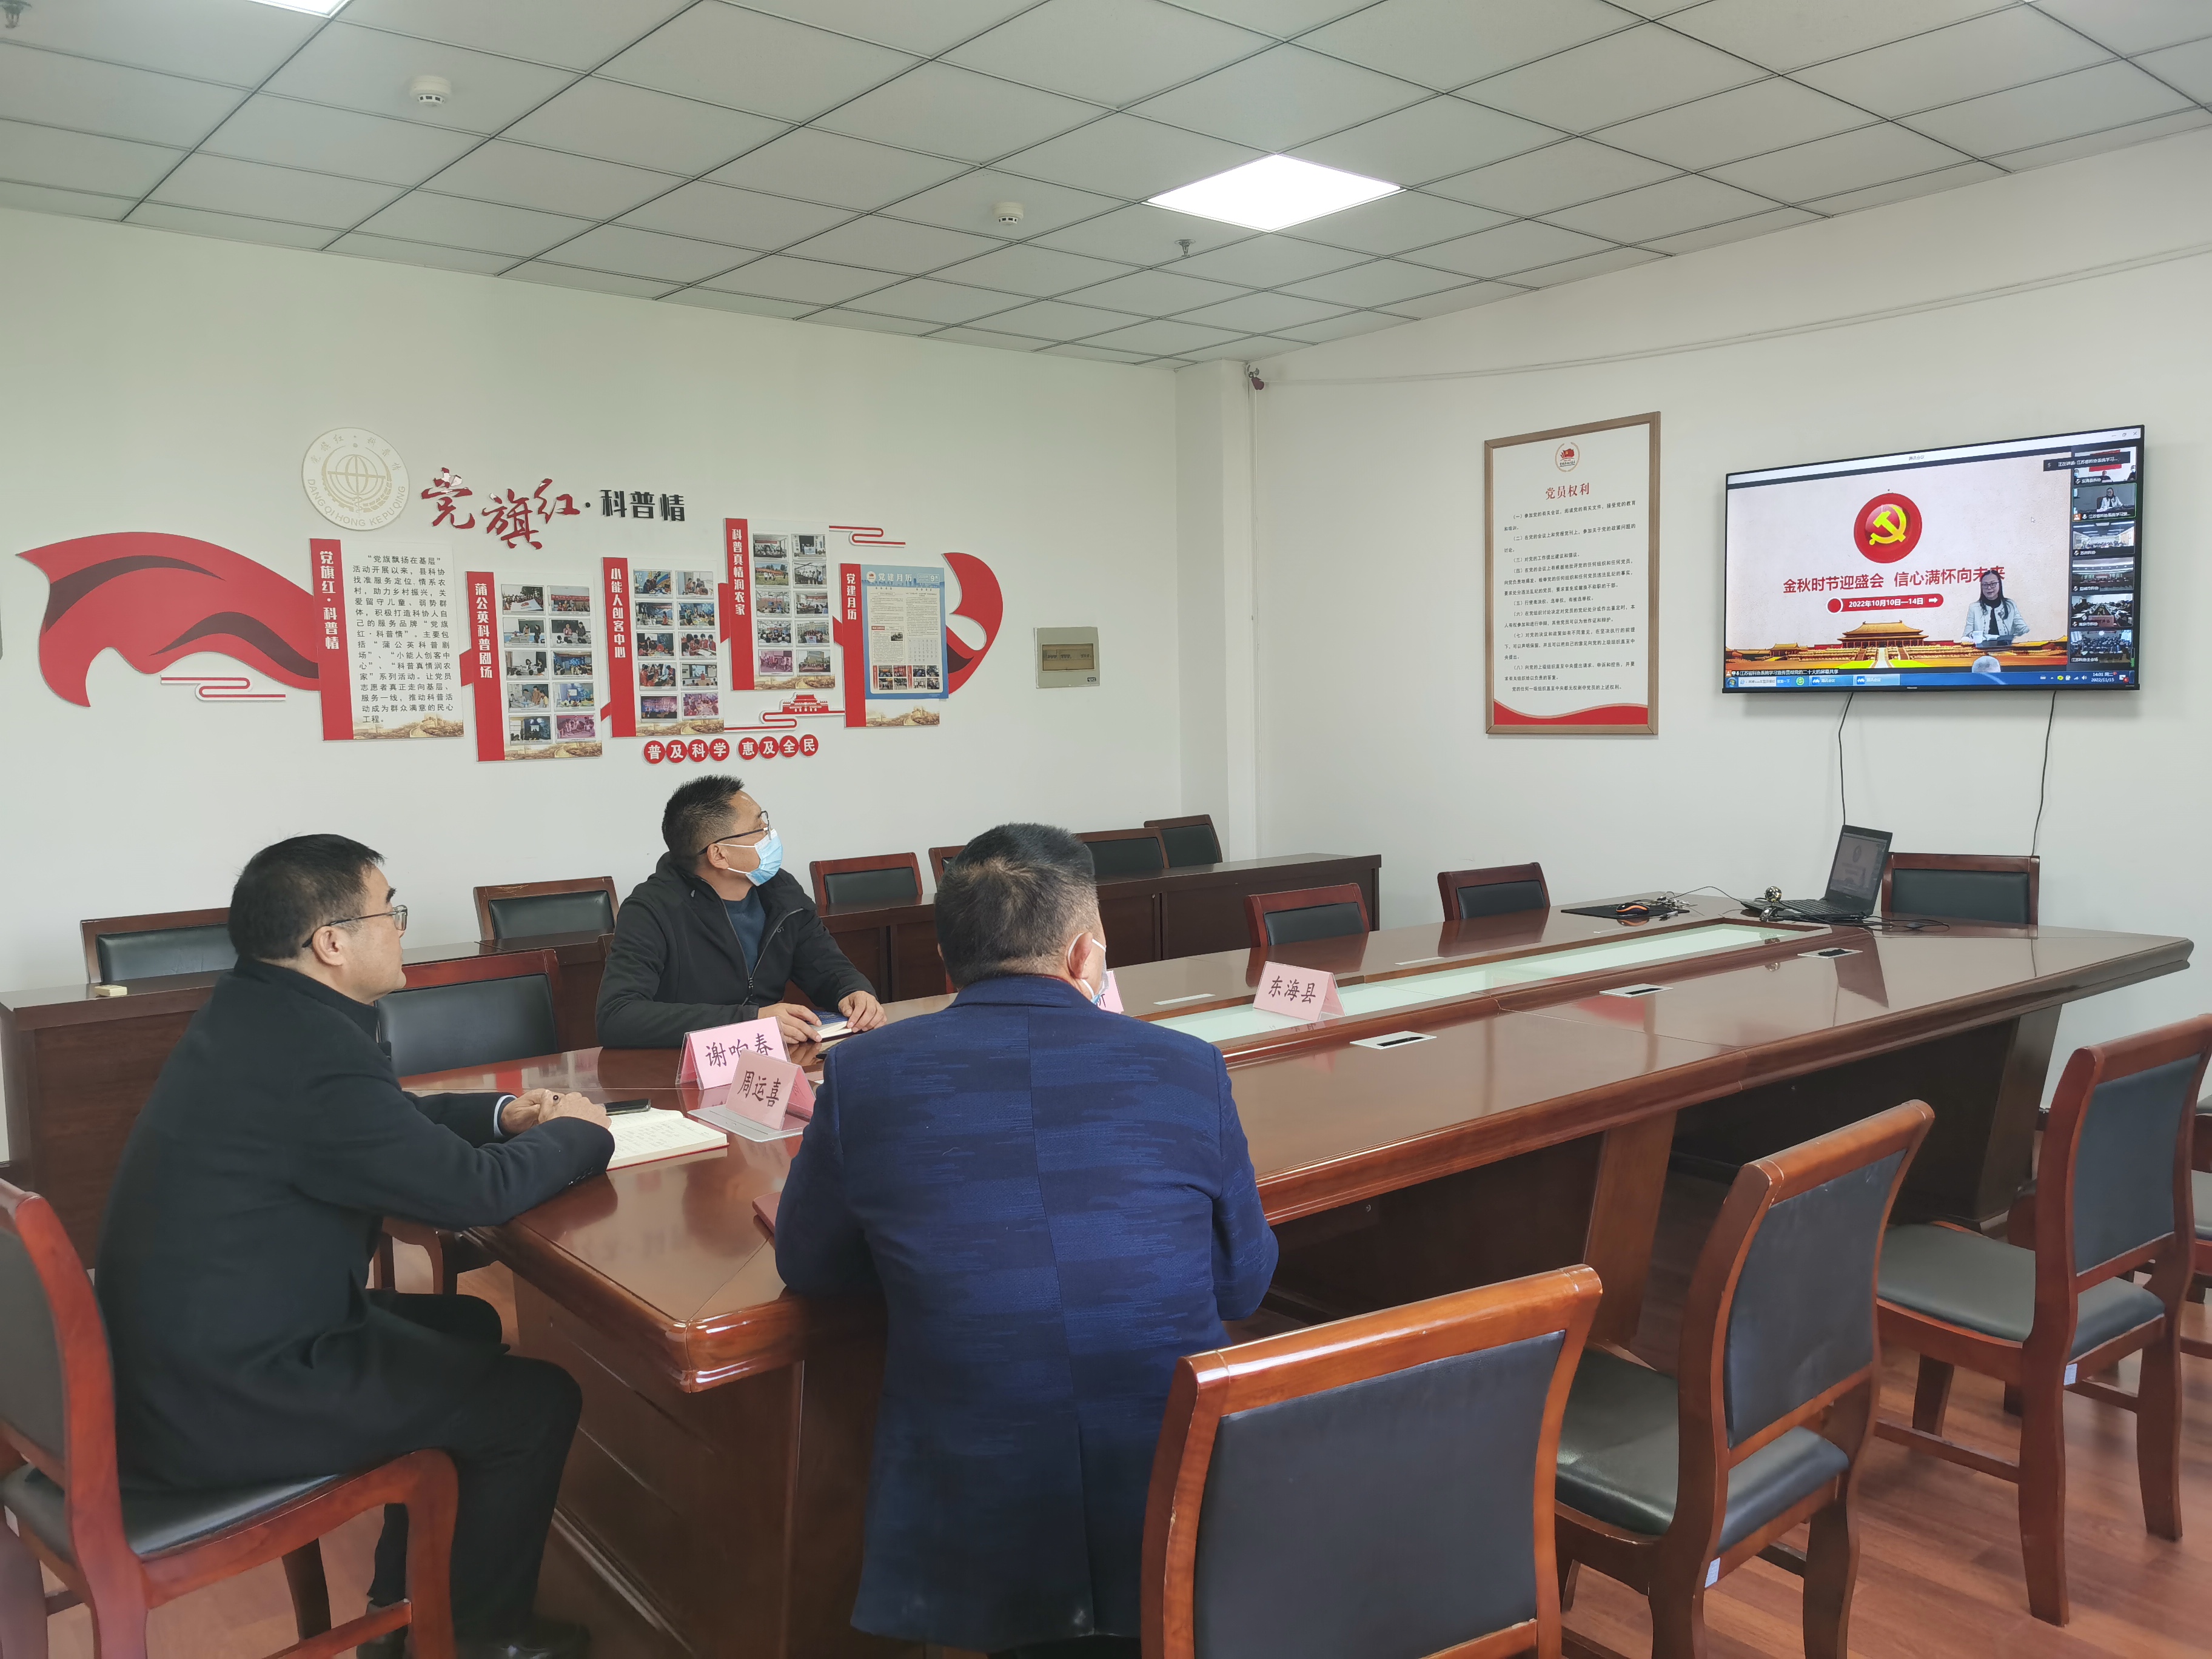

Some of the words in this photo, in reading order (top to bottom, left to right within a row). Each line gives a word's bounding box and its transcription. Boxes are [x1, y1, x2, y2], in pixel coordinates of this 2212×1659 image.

[1545, 482, 1589, 500] 党员权利
[307, 479, 326, 507] DANG
[324, 506, 335, 516] QI
[335, 514, 366, 526] HONG
[369, 516, 383, 526] KE
[382, 508, 395, 520] PU
[392, 486, 406, 509] QING
[353, 565, 445, 576] 活动开展以来，县科协
[731, 529, 745, 615] 科普真情润农家
[878, 573, 913, 582] 党建月历
[354, 587, 446, 597] 村，助力乡村振兴，关
[1783, 572, 1884, 594] 金秋时节迎盛会
[319, 551, 340, 649] 党旗红·科普情
[355, 597, 447, 607] 爱留守儿童、弱势群
[846, 573, 857, 621] 党建月历
[355, 608, 447, 618] 体，积极打造科协人自
[610, 568, 626, 659] 小能人创客中心
[474, 583, 493, 679] 蒲公英科普剧场
[360, 683, 449, 691] 志愿者真正走向基层、
[361, 693, 454, 702] 服务一线，推动科普活
[362, 703, 454, 712] 动成为群众满意的民心
[648, 742, 726, 759] 普及科学
[743, 737, 816, 756] 惠及全民
[1268, 975, 1316, 1004] 东海县
[737, 1070, 782, 1107] 周运喜
